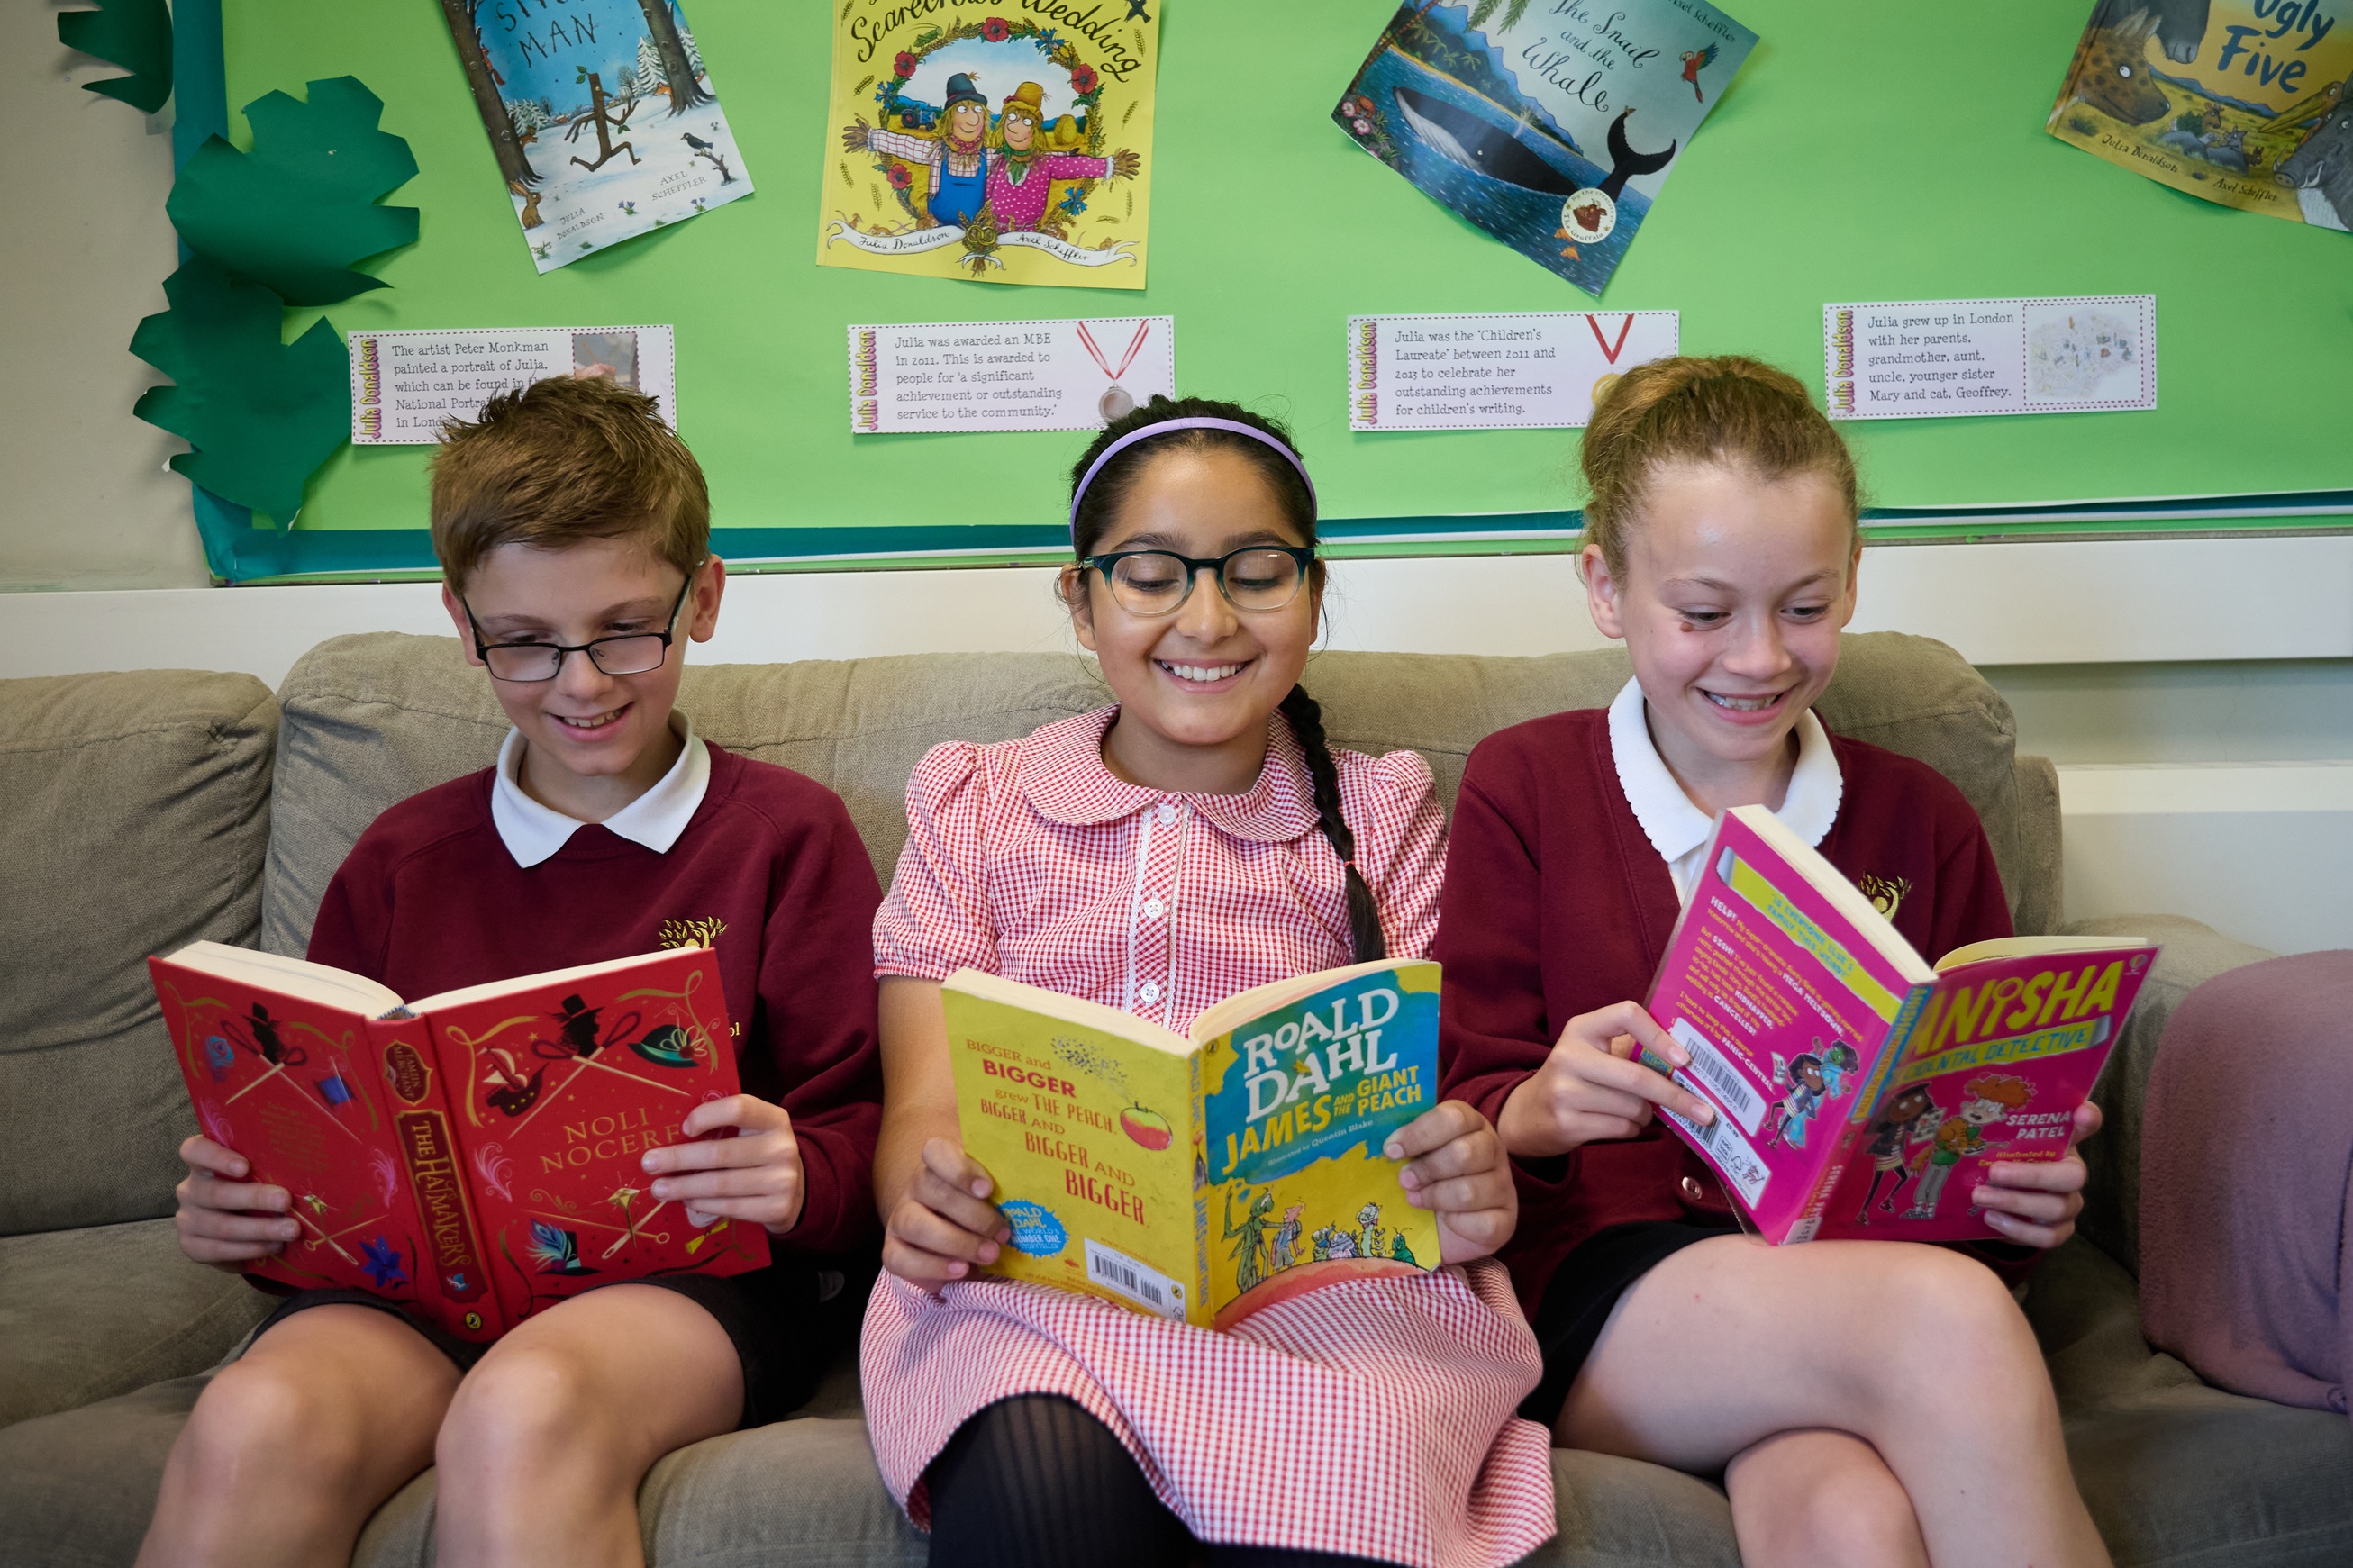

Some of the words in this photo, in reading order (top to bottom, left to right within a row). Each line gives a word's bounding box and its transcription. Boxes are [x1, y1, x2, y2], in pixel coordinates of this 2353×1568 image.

[1694, 9, 1735, 42] Scheffler
[2254, 0, 2335, 51] Ugly
[519, 14, 596, 68] MAN
[1560, 31, 1585, 53] and
[1588, 47, 1614, 70] the
[1593, 11, 1660, 68] Snail
[2217, 25, 2306, 93] Five
[1522, 36, 1610, 113] Whale
[2102, 134, 2130, 153] Julia
[2131, 146, 2178, 173] Donaldson
[652, 176, 707, 201] SCHEFFLER
[660, 170, 687, 186] AXEL
[2213, 178, 2236, 193] Axel
[557, 213, 604, 240] DONALDSON
[559, 207, 586, 224] JULIA
[859, 236, 888, 250] Julia
[892, 232, 949, 250] Donaldson
[1015, 233, 1041, 246] Axel
[1044, 238, 1089, 260] Scheffler
[1571, 230, 1603, 241] Gruffalo
[1868, 316, 1898, 329] Julia
[1903, 318, 1930, 329] grew
[1934, 317, 1949, 327] up
[1953, 314, 1965, 325] in
[1970, 313, 2013, 324] London
[392, 345, 414, 357] The
[418, 344, 450, 356] artist
[455, 343, 485, 355] Peter
[488, 341, 549, 353] Monkman
[895, 337, 924, 349] Julia
[928, 339, 949, 347] was
[953, 334, 1001, 347] awarded
[1004, 337, 1019, 345] an
[1023, 332, 1051, 345] MBE
[1395, 331, 1425, 343] Julia
[1428, 333, 1450, 341] was
[1454, 330, 1474, 341] the
[1831, 310, 1854, 377] Donaldson
[1868, 334, 1895, 346] with
[1900, 334, 1920, 345] her
[855, 331, 877, 396] Donaldson
[896, 358, 908, 366] in
[912, 357, 939, 366] 2011.
[943, 353, 969, 365] This
[974, 353, 983, 364] is
[987, 351, 1034, 364] awarded
[1039, 352, 1050, 363] to
[1356, 322, 1377, 389] Donaldson
[1453, 349, 1502, 360] between
[1506, 350, 1530, 358] 2011
[1533, 347, 1556, 358] and
[359, 339, 381, 404] Donaldson
[394, 362, 438, 376] painted
[441, 365, 448, 373] a
[451, 360, 495, 375] portrait
[499, 359, 512, 371] of
[896, 372, 933, 386] people
[938, 372, 954, 383] for
[971, 370, 1034, 384] significant
[1395, 371, 1417, 380] 2013
[1422, 368, 1433, 378] to
[1438, 367, 1492, 378] celebrate
[1496, 366, 1515, 377] her
[1909, 372, 1958, 384] younger
[1962, 368, 1994, 380] sister
[395, 381, 430, 392] which
[433, 383, 454, 392] can
[458, 379, 470, 391] be
[476, 377, 511, 390] found
[896, 390, 972, 402] achievement
[977, 392, 988, 400] or
[993, 387, 1061, 400] outstanding
[1395, 385, 1466, 398] outstanding
[1469, 384, 1552, 396] achievements
[1833, 380, 1855, 413] Julia
[1870, 390, 1901, 403] Mary
[1903, 388, 1926, 401] and
[1956, 385, 2012, 399] Geoffrey.
[395, 398, 447, 411] National
[857, 399, 878, 431] Julia
[897, 408, 938, 420] service
[942, 408, 954, 419] to
[958, 407, 977, 419] the
[1357, 393, 1378, 425] Julia
[1396, 404, 1413, 415] for
[1417, 403, 1475, 415] children's
[1478, 403, 1525, 415] writing.
[359, 408, 382, 440] Julia
[396, 417, 409, 428] in
[1710, 896, 1736, 921] HELP!
[1712, 935, 1735, 956] SSSH!
[1783, 973, 1803, 995] MEGA
[1713, 995, 1756, 1036] CANCELLED!
[1911, 960, 2124, 1056] ANISHA
[1243, 988, 1399, 1080] ROALD
[1985, 1027, 2088, 1059] DETECTIVE
[966, 1039, 1022, 1062] BIGGER
[1025, 1055, 1052, 1070] and
[982, 1058, 1077, 1099] BIGGER
[1245, 1029, 1398, 1123] DAHL
[995, 1088, 1029, 1104] grew
[1032, 1092, 1060, 1116] THE
[1333, 1104, 1351, 1117] THE
[1358, 1083, 1422, 1117] PEACH
[563, 1107, 650, 1144] NOLI
[980, 1098, 1026, 1125] BIGGER
[1031, 1118, 1065, 1135] AND
[1222, 1094, 1331, 1175] JAMES
[1333, 1092, 1355, 1107] AND
[1357, 1065, 1419, 1098] GIANT
[2005, 1111, 2072, 1127] SERENA
[413, 1121, 437, 1157] THE
[1311, 1128, 1347, 1147] Quentin
[1349, 1120, 1374, 1133] Blake
[2015, 1126, 2065, 1139] PATEL
[1024, 1131, 1089, 1170] BIGGER
[1095, 1161, 1135, 1187] AND
[1013, 1218, 1047, 1228] DAHL
[1044, 1234, 1061, 1243] ONE
